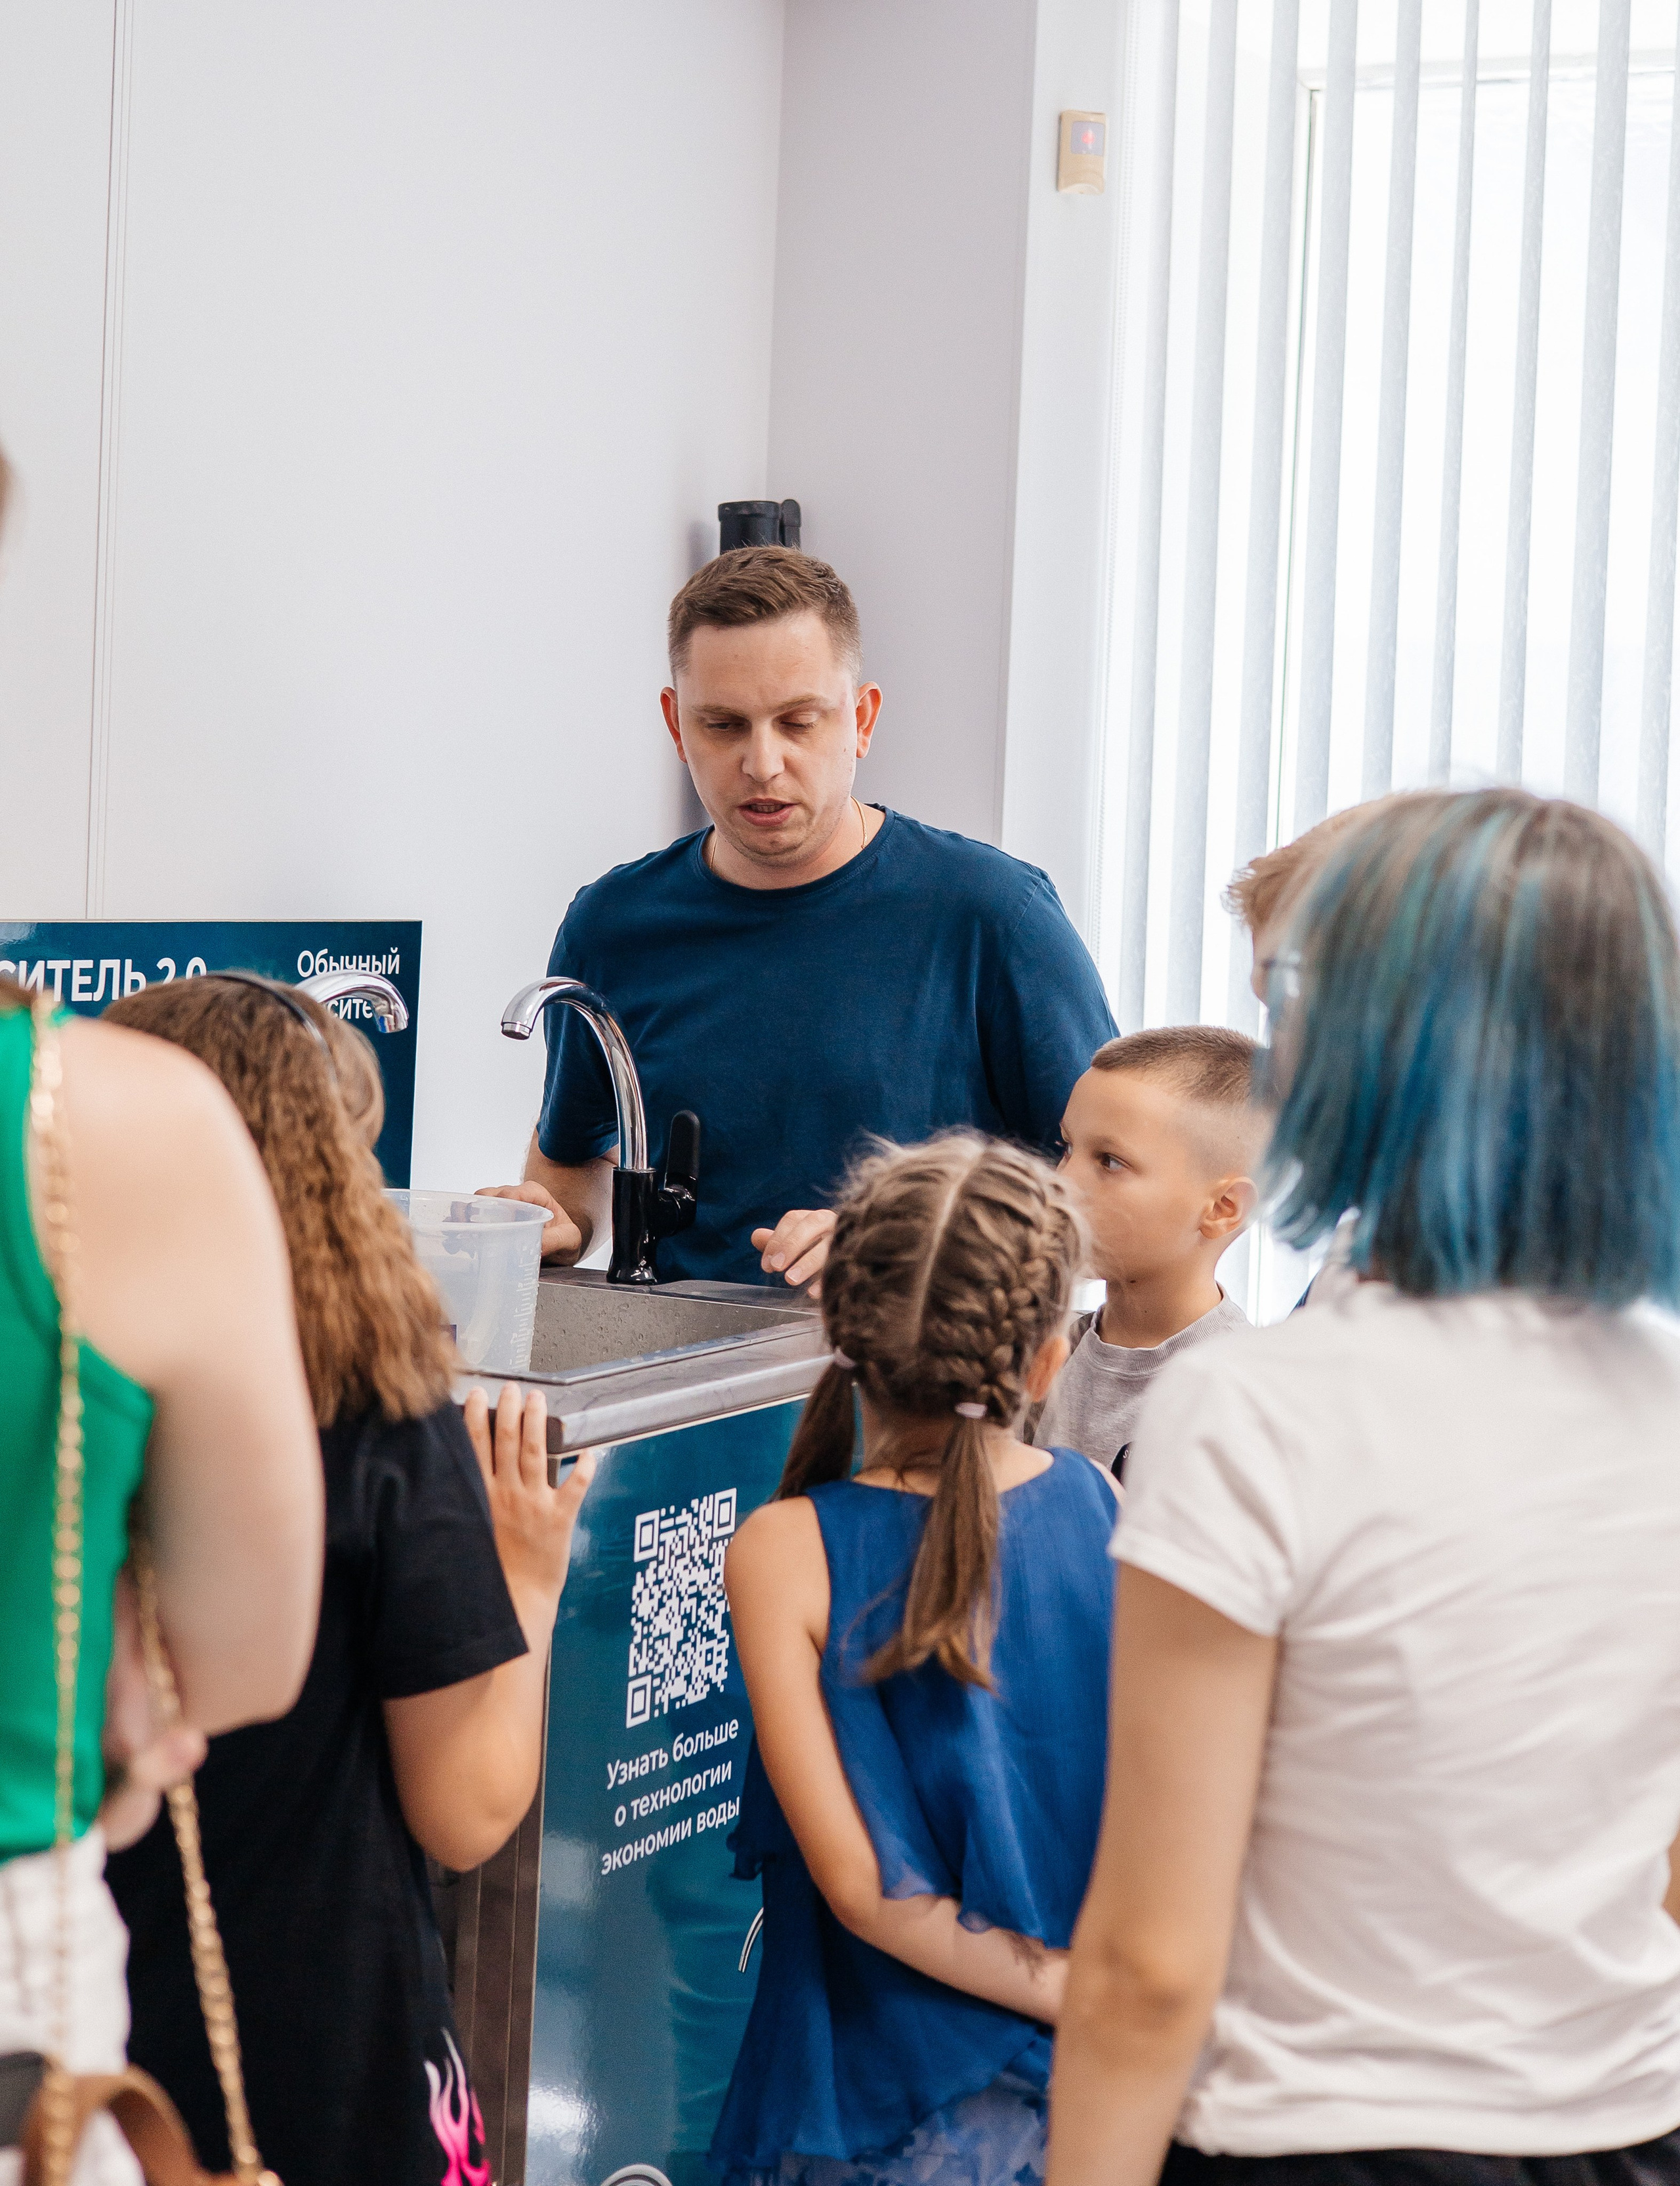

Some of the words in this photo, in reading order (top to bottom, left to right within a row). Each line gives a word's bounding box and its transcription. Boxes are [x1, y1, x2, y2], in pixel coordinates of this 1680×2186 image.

[0, 959, 146, 1002] ИТЕЛЬ
[297, 947, 400, 978] Обычный
[606, 1748, 669, 1790] Узнать
[672, 1719, 739, 1762] больше
[614, 1805, 627, 1828] о
[630, 1760, 732, 1820] технологии
[600, 1817, 692, 1876] экономии
[696, 1796, 740, 1834] воды
